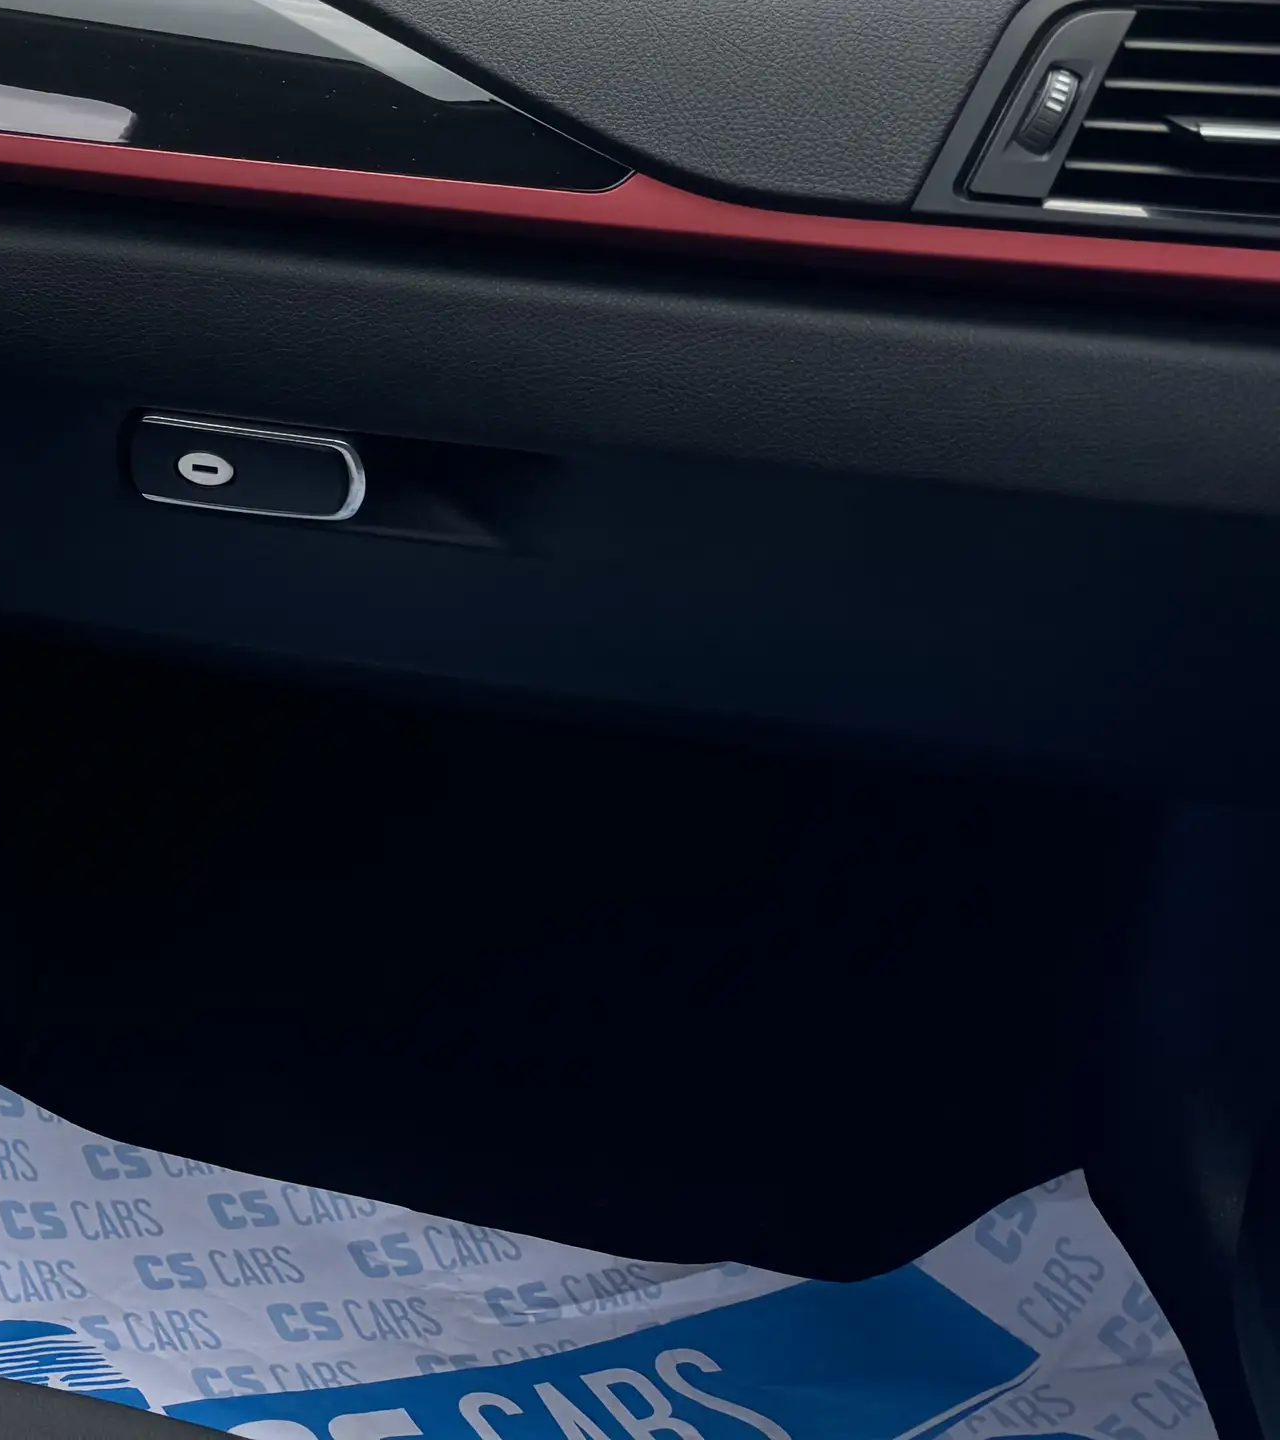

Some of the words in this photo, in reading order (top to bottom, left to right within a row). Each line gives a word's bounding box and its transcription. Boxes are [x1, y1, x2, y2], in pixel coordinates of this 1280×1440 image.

[81, 1143, 153, 1182] CS
[68, 1197, 165, 1242] CARS
[206, 1189, 281, 1231] CS
[131, 1252, 209, 1291] CS
[206, 1245, 306, 1288] CARS
[346, 1231, 424, 1279] CS
[421, 1223, 523, 1271] CARS
[482, 1281, 563, 1328] CS
[559, 1261, 664, 1317] CARS
[1016, 1236, 1105, 1340] CARS
[77, 1315, 122, 1352] S
[121, 1308, 223, 1352] CARS
[265, 1301, 345, 1343] CS
[340, 1296, 445, 1343] CARS
